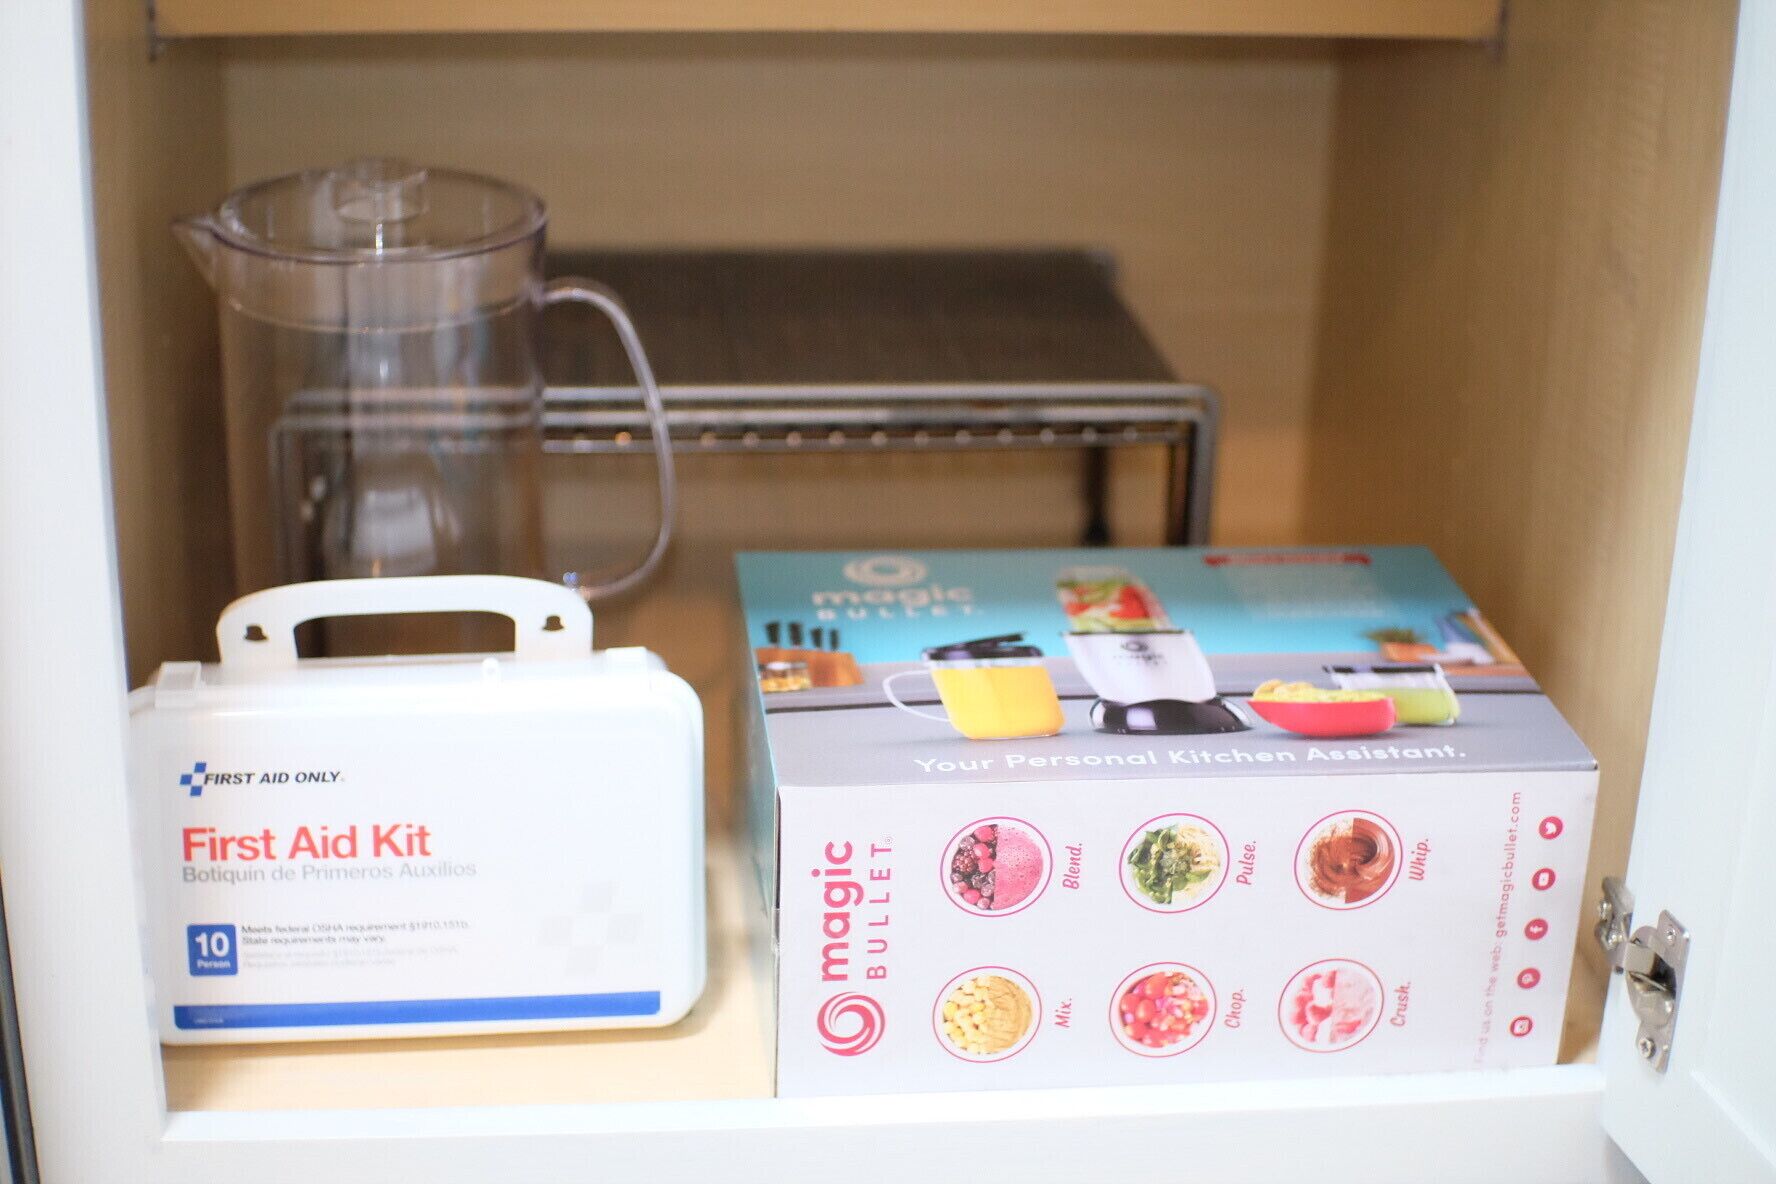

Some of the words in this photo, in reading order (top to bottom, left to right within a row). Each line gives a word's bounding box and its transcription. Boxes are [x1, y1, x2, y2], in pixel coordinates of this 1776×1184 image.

[812, 583, 973, 608] magic
[914, 758, 994, 774] Your
[1005, 750, 1158, 769] Personal
[1167, 748, 1297, 766] Kitchen
[1306, 744, 1467, 762] Assistant.
[203, 773, 255, 786] FIRST
[259, 772, 289, 785] AID
[295, 771, 342, 784] ONLY
[182, 826, 277, 862] First
[288, 825, 358, 860] Aid
[372, 823, 432, 858] Kit
[1409, 837, 1429, 881] Whip.
[271, 863, 296, 882] de
[302, 863, 393, 882] Primeros
[399, 860, 478, 879] Auxilios
[1063, 841, 1084, 890] Blend.
[1236, 840, 1258, 886] Pulse.
[1496, 791, 1521, 938] getmagicbullet.com
[811, 840, 865, 982] magic
[195, 931, 230, 959] 10
[241, 925, 273, 935] Meets
[242, 936, 269, 946] State
[270, 935, 337, 947] requirements
[197, 959, 231, 971] Person
[1054, 996, 1073, 1029] Mix.
[1224, 988, 1244, 1029] Chop.
[1391, 981, 1411, 1028] Crush.
